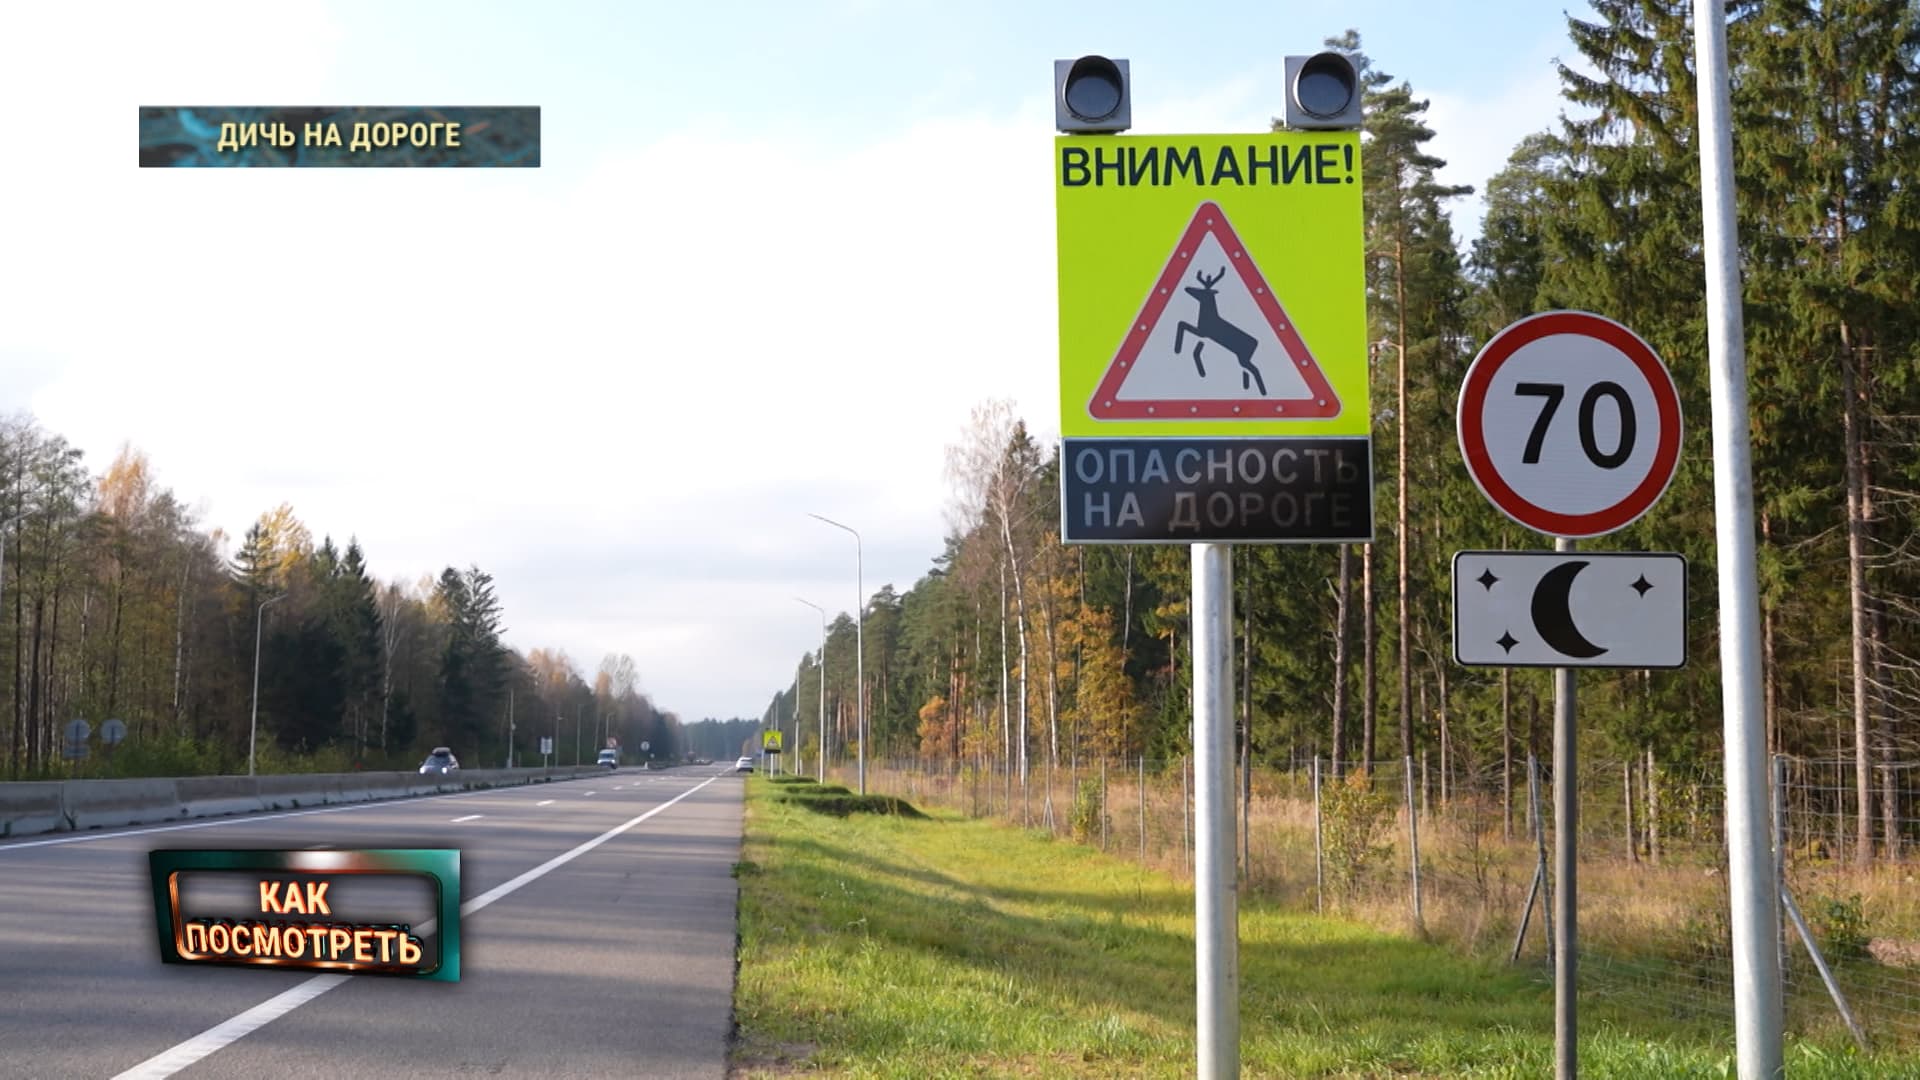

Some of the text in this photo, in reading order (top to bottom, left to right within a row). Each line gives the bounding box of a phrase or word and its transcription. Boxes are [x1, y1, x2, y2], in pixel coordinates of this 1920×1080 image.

[1061, 144, 1354, 186] ВНИМАНИЕ!
[1515, 381, 1637, 469] 70
[1075, 448, 1358, 484] ОПАСНОСТЬ
[1084, 492, 1351, 532] НА ДОРОГЕ
